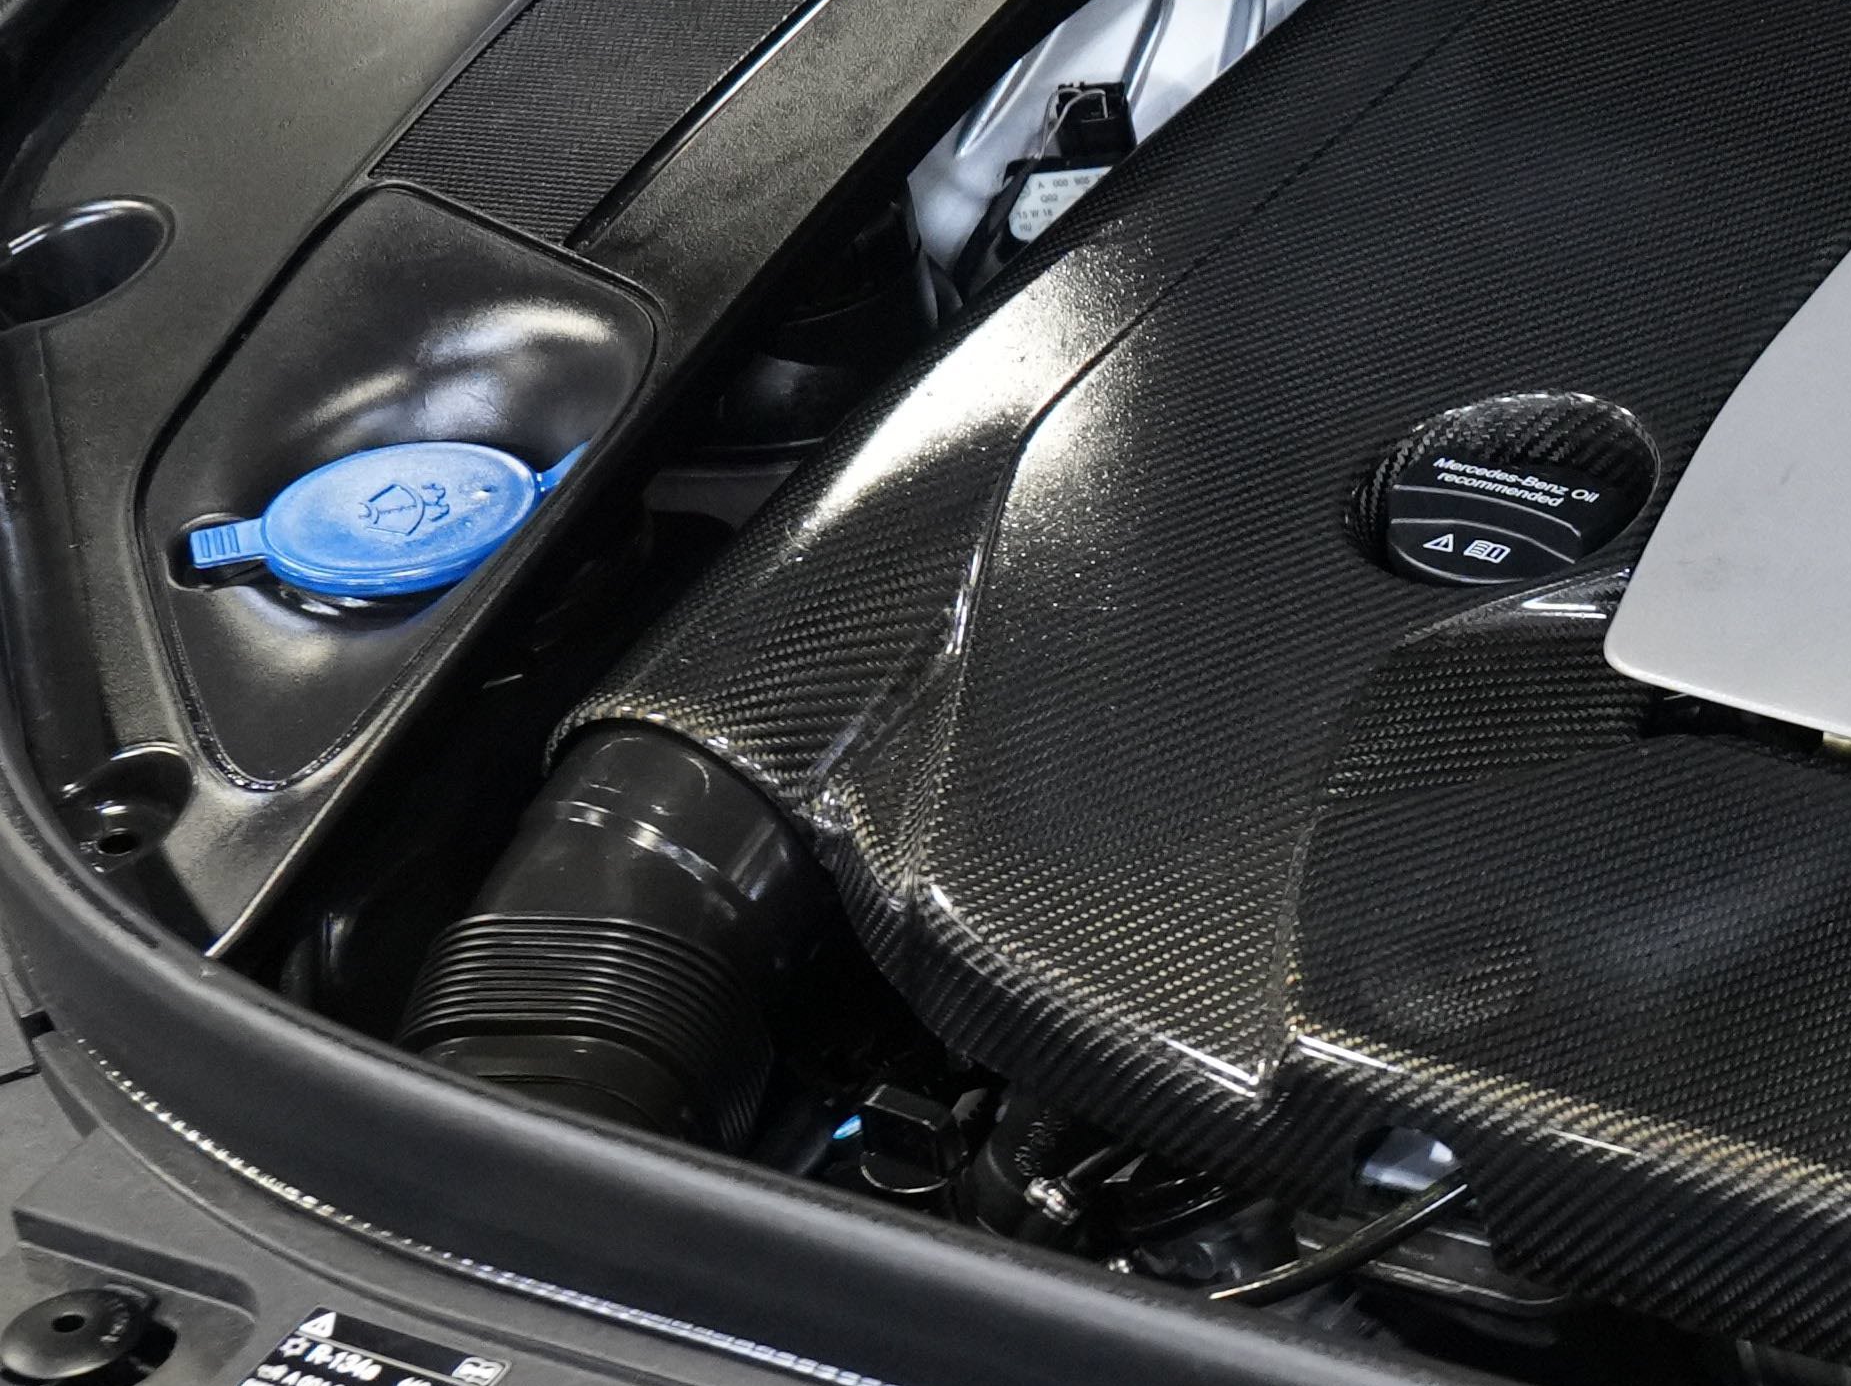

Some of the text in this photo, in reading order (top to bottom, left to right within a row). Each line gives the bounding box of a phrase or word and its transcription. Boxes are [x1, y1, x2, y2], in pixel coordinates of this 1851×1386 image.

[1432, 457, 1600, 504] Mercedes-Benz Oil
[1437, 472, 1565, 507] recommended
